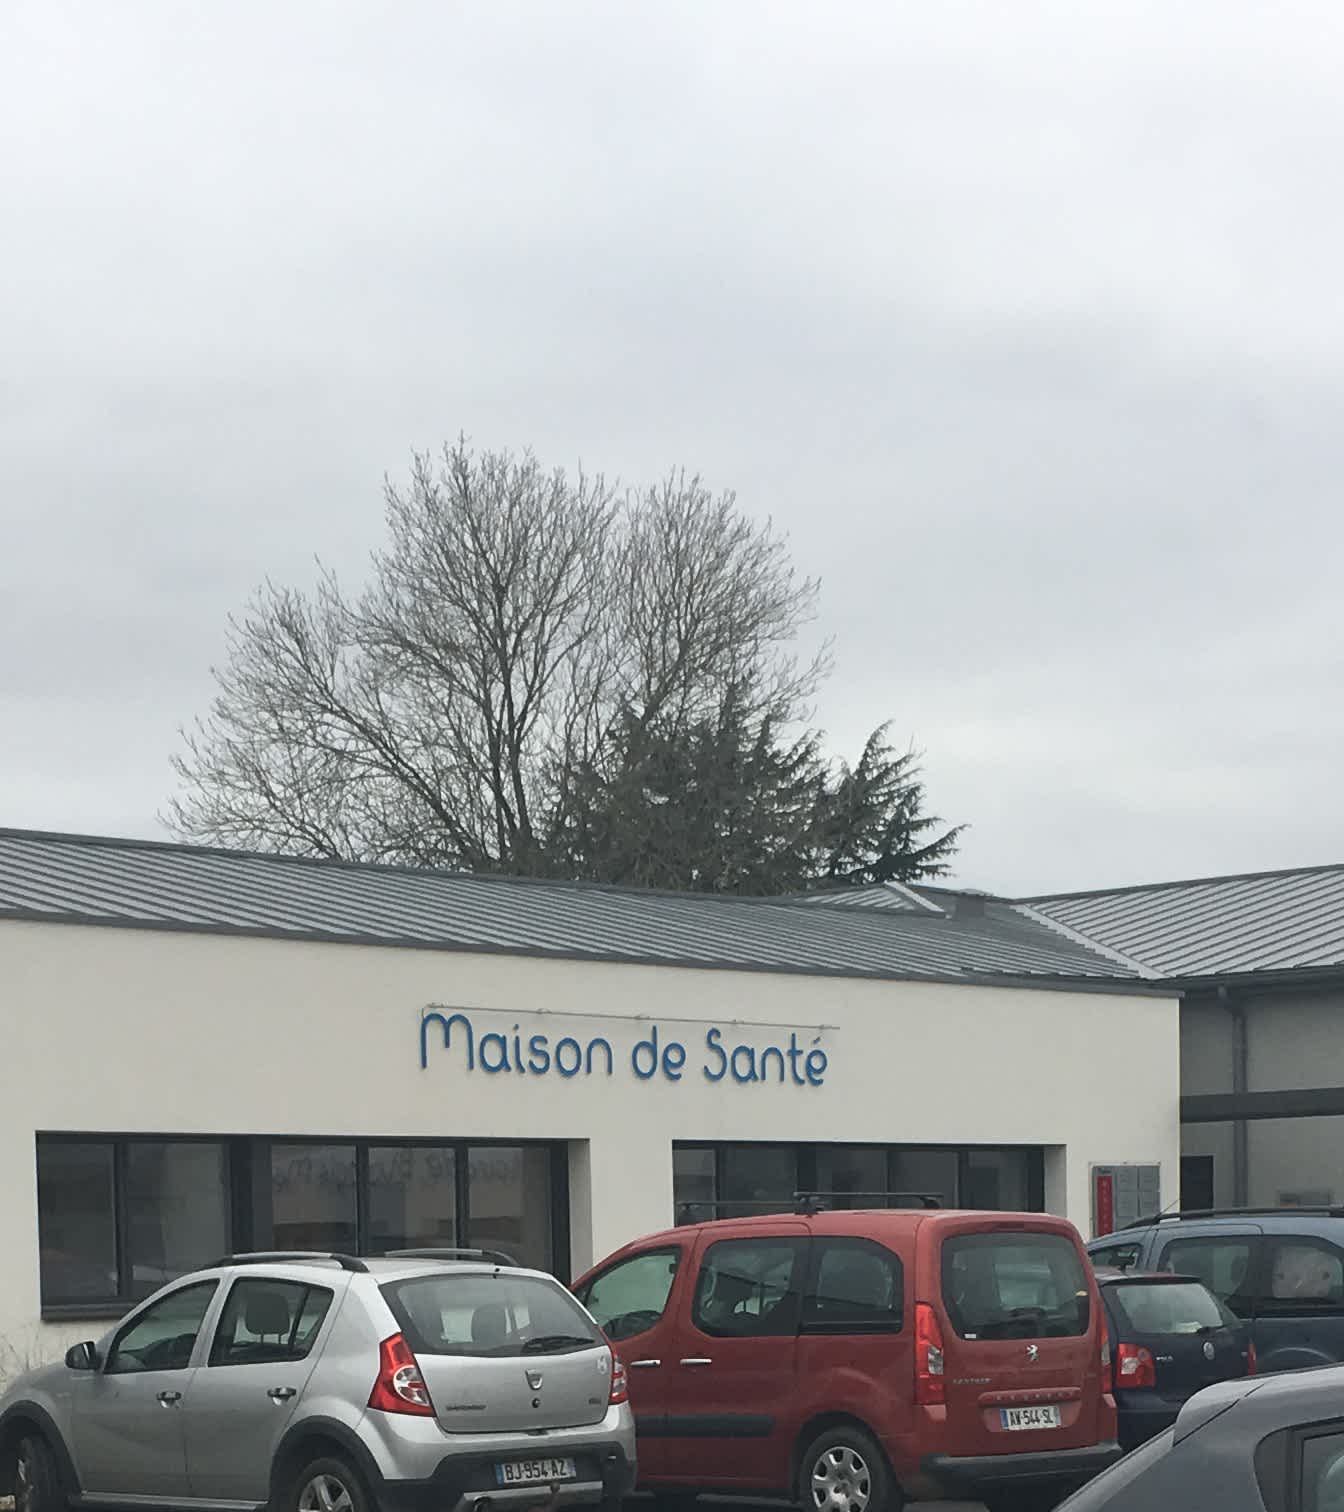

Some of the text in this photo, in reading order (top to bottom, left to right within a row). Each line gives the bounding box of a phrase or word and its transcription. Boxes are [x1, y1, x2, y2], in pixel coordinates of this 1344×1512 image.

[420, 1013, 828, 1087] Maison de Santé
